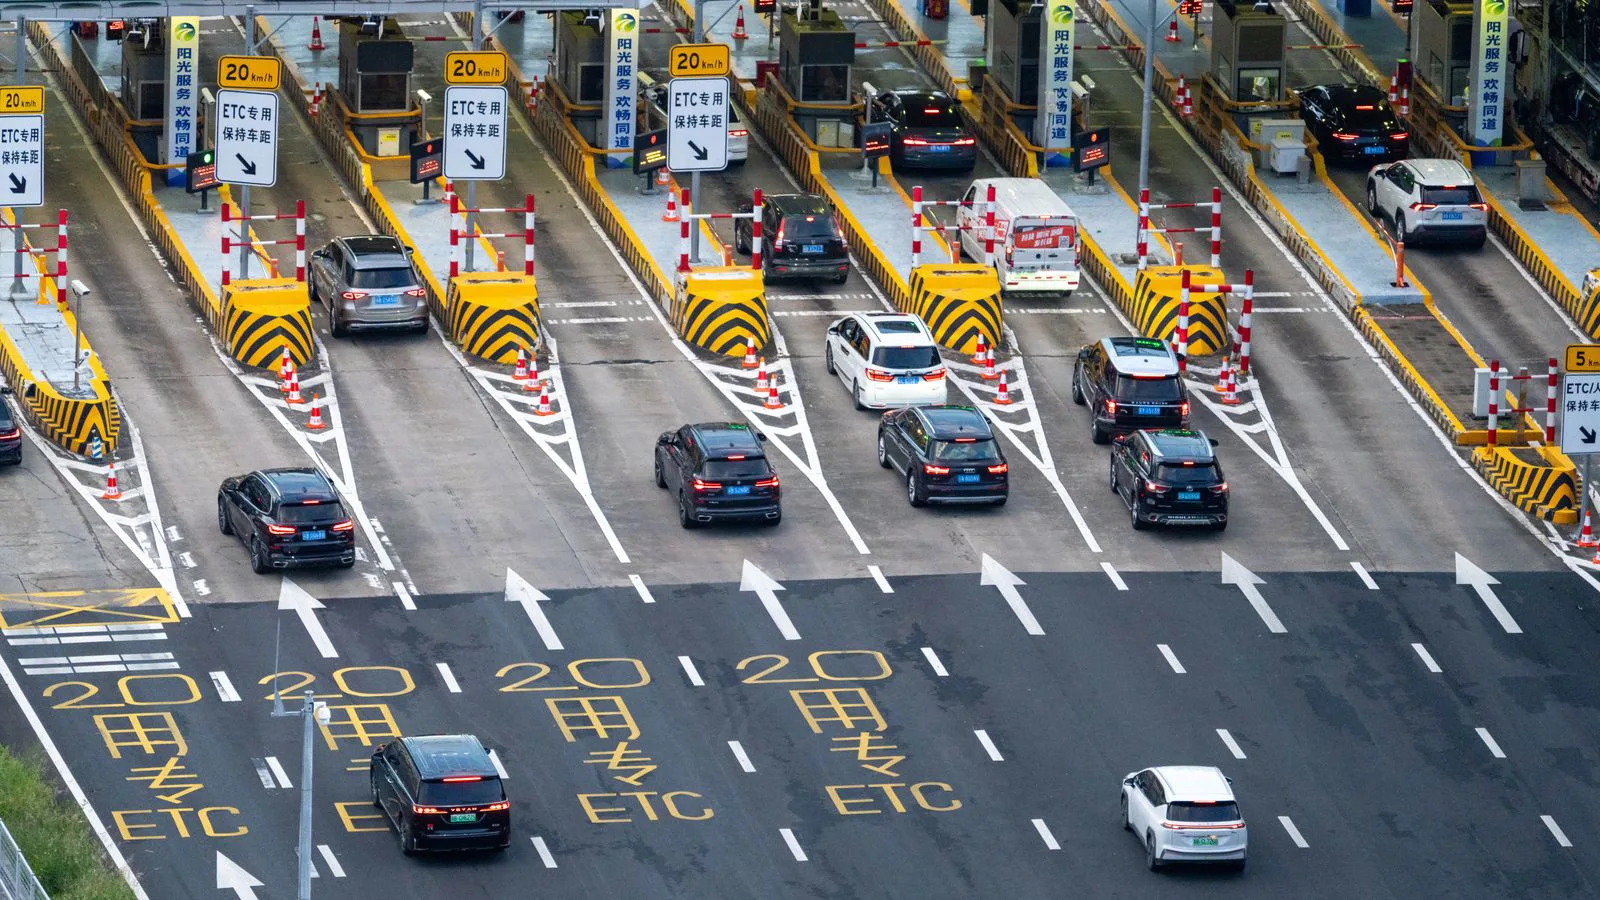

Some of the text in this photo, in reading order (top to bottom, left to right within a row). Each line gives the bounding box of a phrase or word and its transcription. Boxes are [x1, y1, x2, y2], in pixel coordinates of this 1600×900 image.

[677, 52, 723, 70] 20 km/h
[1053, 30, 1069, 82] 阳光服务
[225, 63, 273, 83] 20 km/h
[453, 60, 500, 77] 20 km/h
[1482, 22, 1501, 130] 阳光服务 欢畅同道
[6, 93, 20, 108] 20
[174, 47, 192, 158] 阳光服务 欢畅同道
[614, 38, 632, 148] 阳光服务 欢畅同道
[675, 91, 723, 107] ETC专用
[223, 103, 272, 122] ETC专用
[451, 101, 501, 116] ETC专用
[451, 123, 500, 138] 保持车距
[674, 114, 722, 129] 保持车距
[1, 128, 39, 143] ETC专用
[222, 126, 271, 144] 保持车距
[2, 150, 39, 165] 保持车距
[1576, 351, 1586, 367] 5
[495, 657, 651, 692] 20
[735, 650, 893, 684] 20
[43, 673, 202, 709] 20
[258, 665, 416, 700] 20
[576, 791, 714, 823] ETC
[825, 781, 963, 815] ETC
[111, 806, 249, 840] ETC
